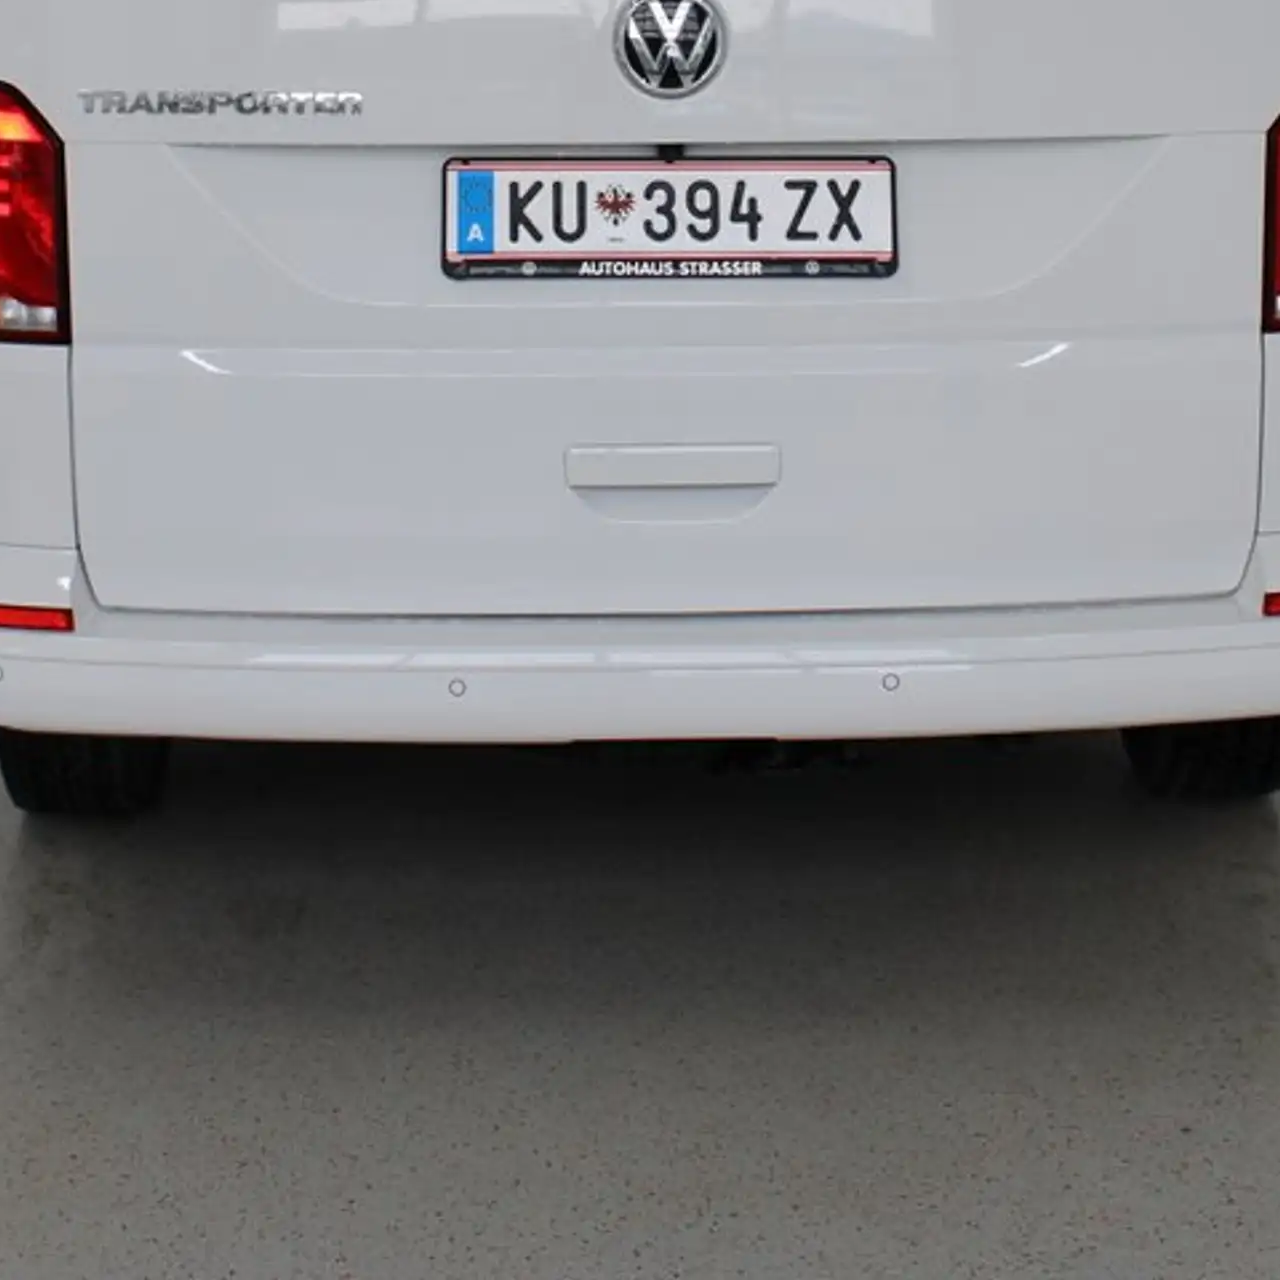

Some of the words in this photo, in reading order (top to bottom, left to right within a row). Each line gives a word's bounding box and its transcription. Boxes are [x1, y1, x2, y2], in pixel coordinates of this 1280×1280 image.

[77, 90, 363, 115] TRANSPORTER
[508, 180, 587, 244] KU
[642, 180, 763, 243] 394
[784, 179, 863, 242] ZX
[466, 223, 485, 242] A
[578, 261, 675, 277] AUTOHAUS
[679, 261, 763, 277] STRASSER
